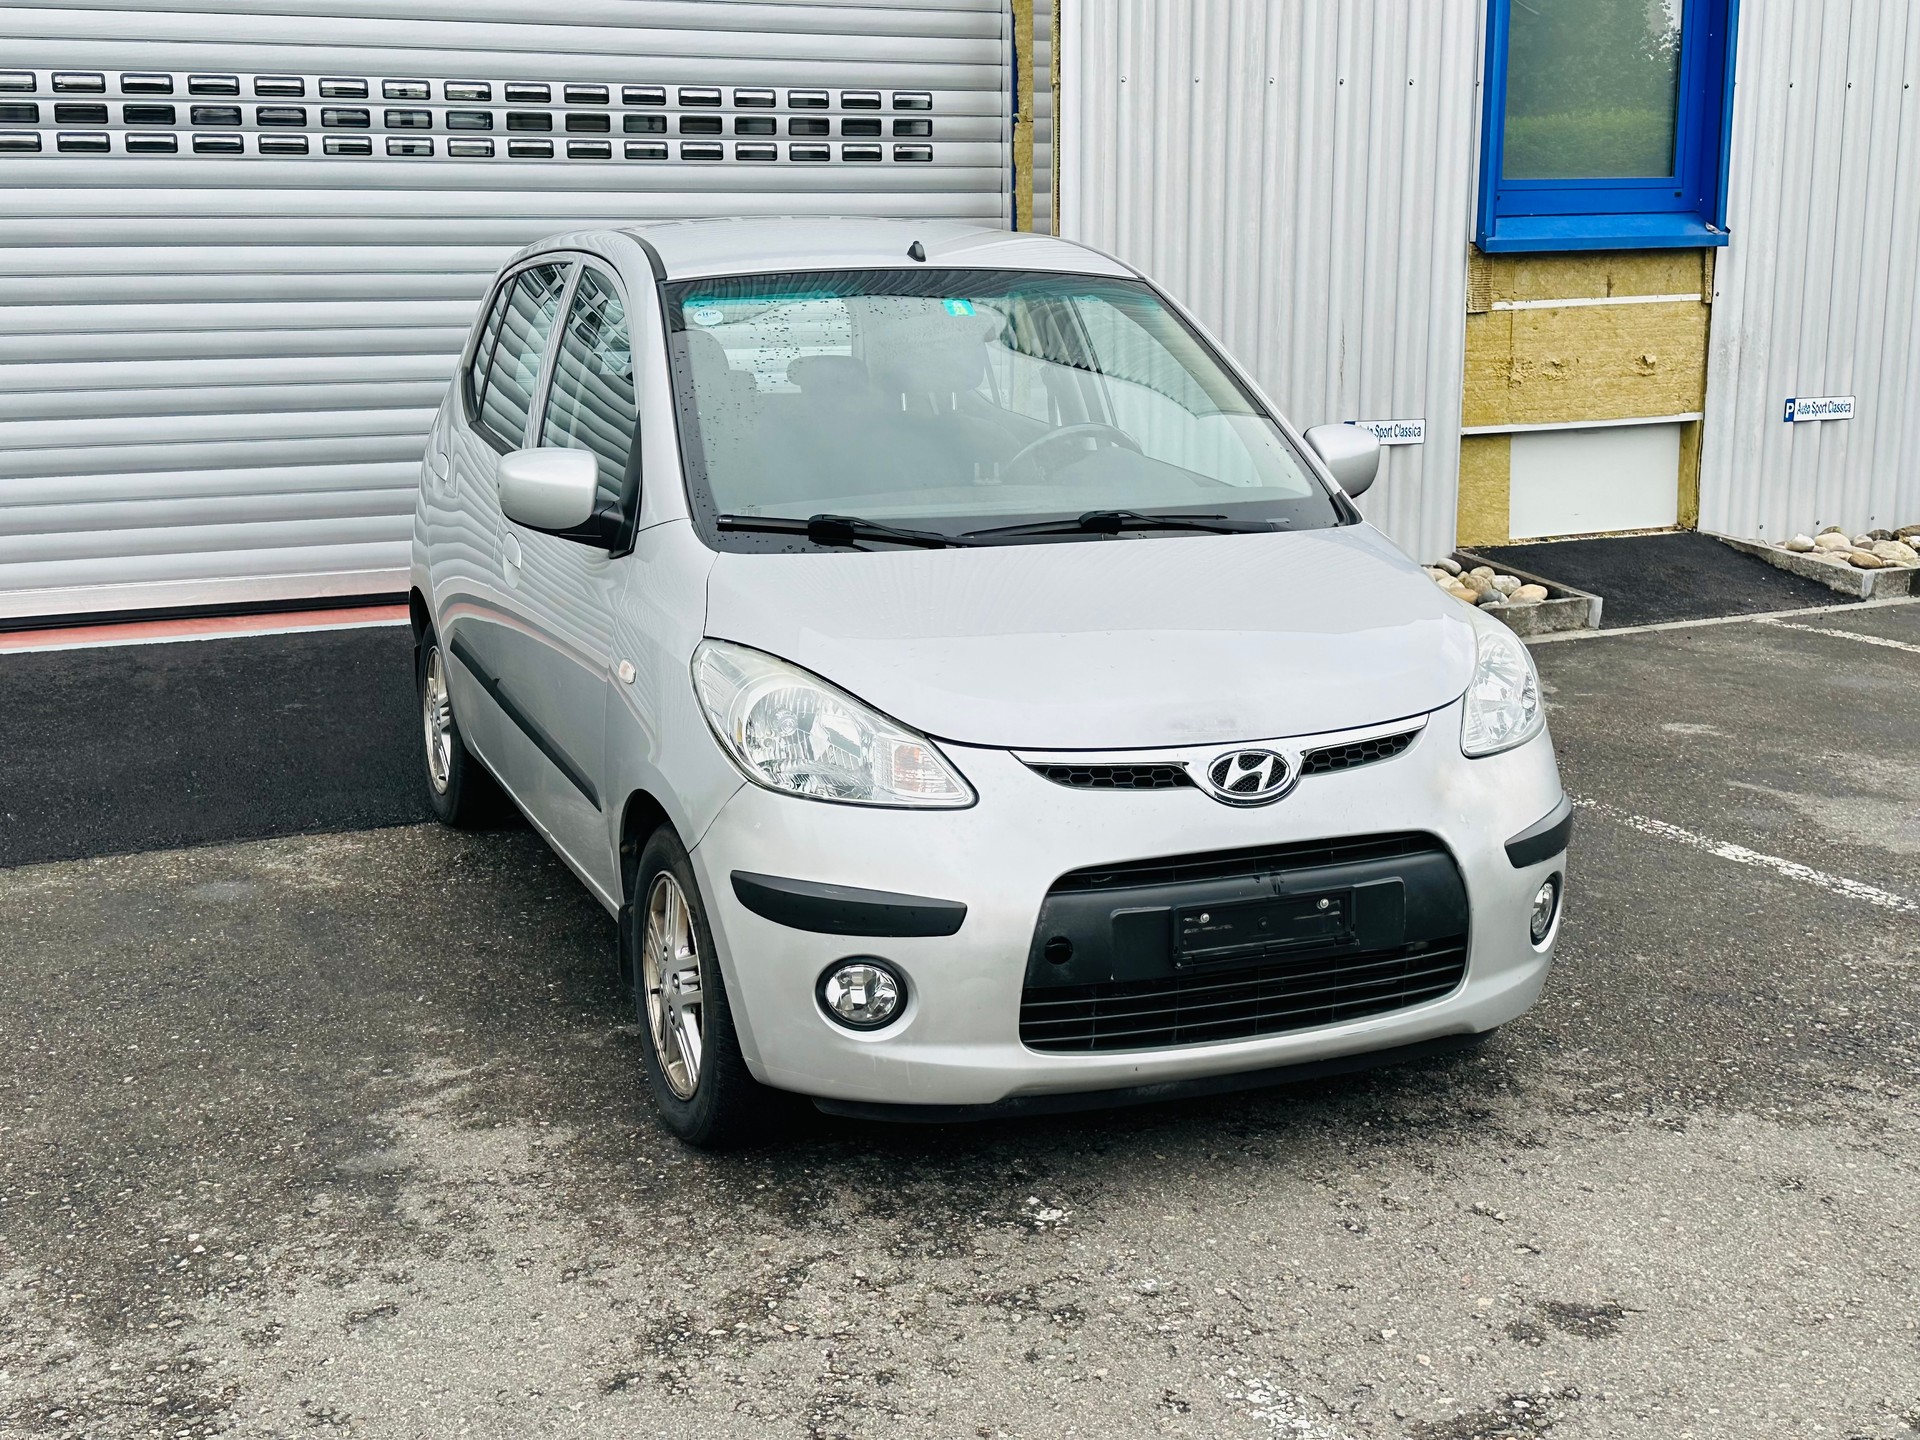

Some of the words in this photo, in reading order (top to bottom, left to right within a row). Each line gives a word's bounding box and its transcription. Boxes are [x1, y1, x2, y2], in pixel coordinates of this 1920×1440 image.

[1785, 402, 1795, 419] P
[1797, 402, 1811, 415] Auto
[1811, 401, 1828, 417] Sport
[1828, 400, 1851, 413] Classica
[1374, 424, 1393, 438] Sport
[1394, 423, 1422, 438] Classica
